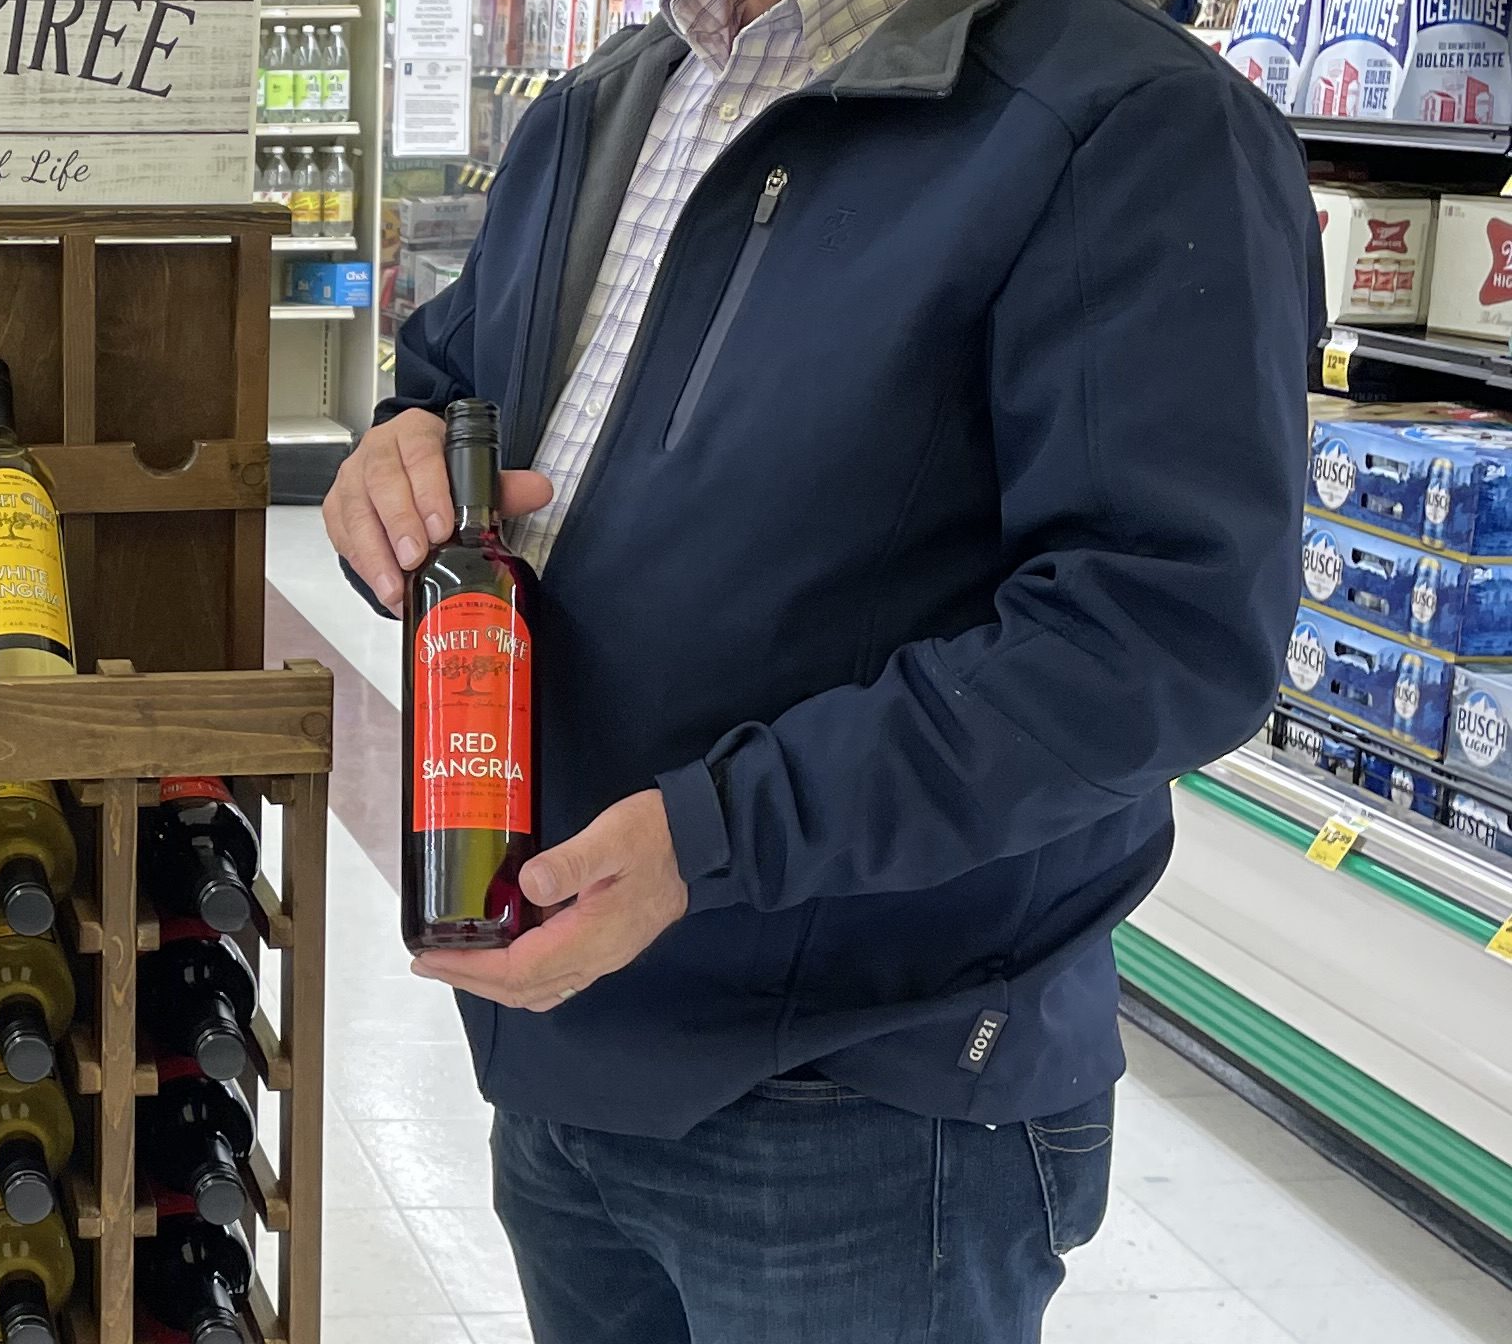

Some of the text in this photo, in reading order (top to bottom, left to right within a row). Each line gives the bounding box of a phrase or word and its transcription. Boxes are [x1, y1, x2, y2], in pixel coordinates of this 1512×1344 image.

[1416, 52, 1506, 69] BOLDER TASTE
[1365, 69, 1391, 86] BOLDER
[1363, 87, 1389, 111] TASTE
[21, 149, 90, 192] Life
[1314, 457, 1356, 489] BUSCH
[1486, 465, 1506, 481] 24
[1303, 548, 1342, 581] BUSCH
[1472, 568, 1493, 582] 24
[419, 626, 529, 664] SWEET TREE
[1288, 639, 1325, 674] BUSCH
[450, 732, 497, 754] RED
[1282, 723, 1323, 760] BUSCH
[1457, 708, 1507, 748] BUSCH
[1464, 736, 1494, 755] LIGHT
[422, 757, 524, 782] SANGRIA
[1448, 806, 1497, 850] BUSCH
[970, 1019, 997, 1062] IZOD
